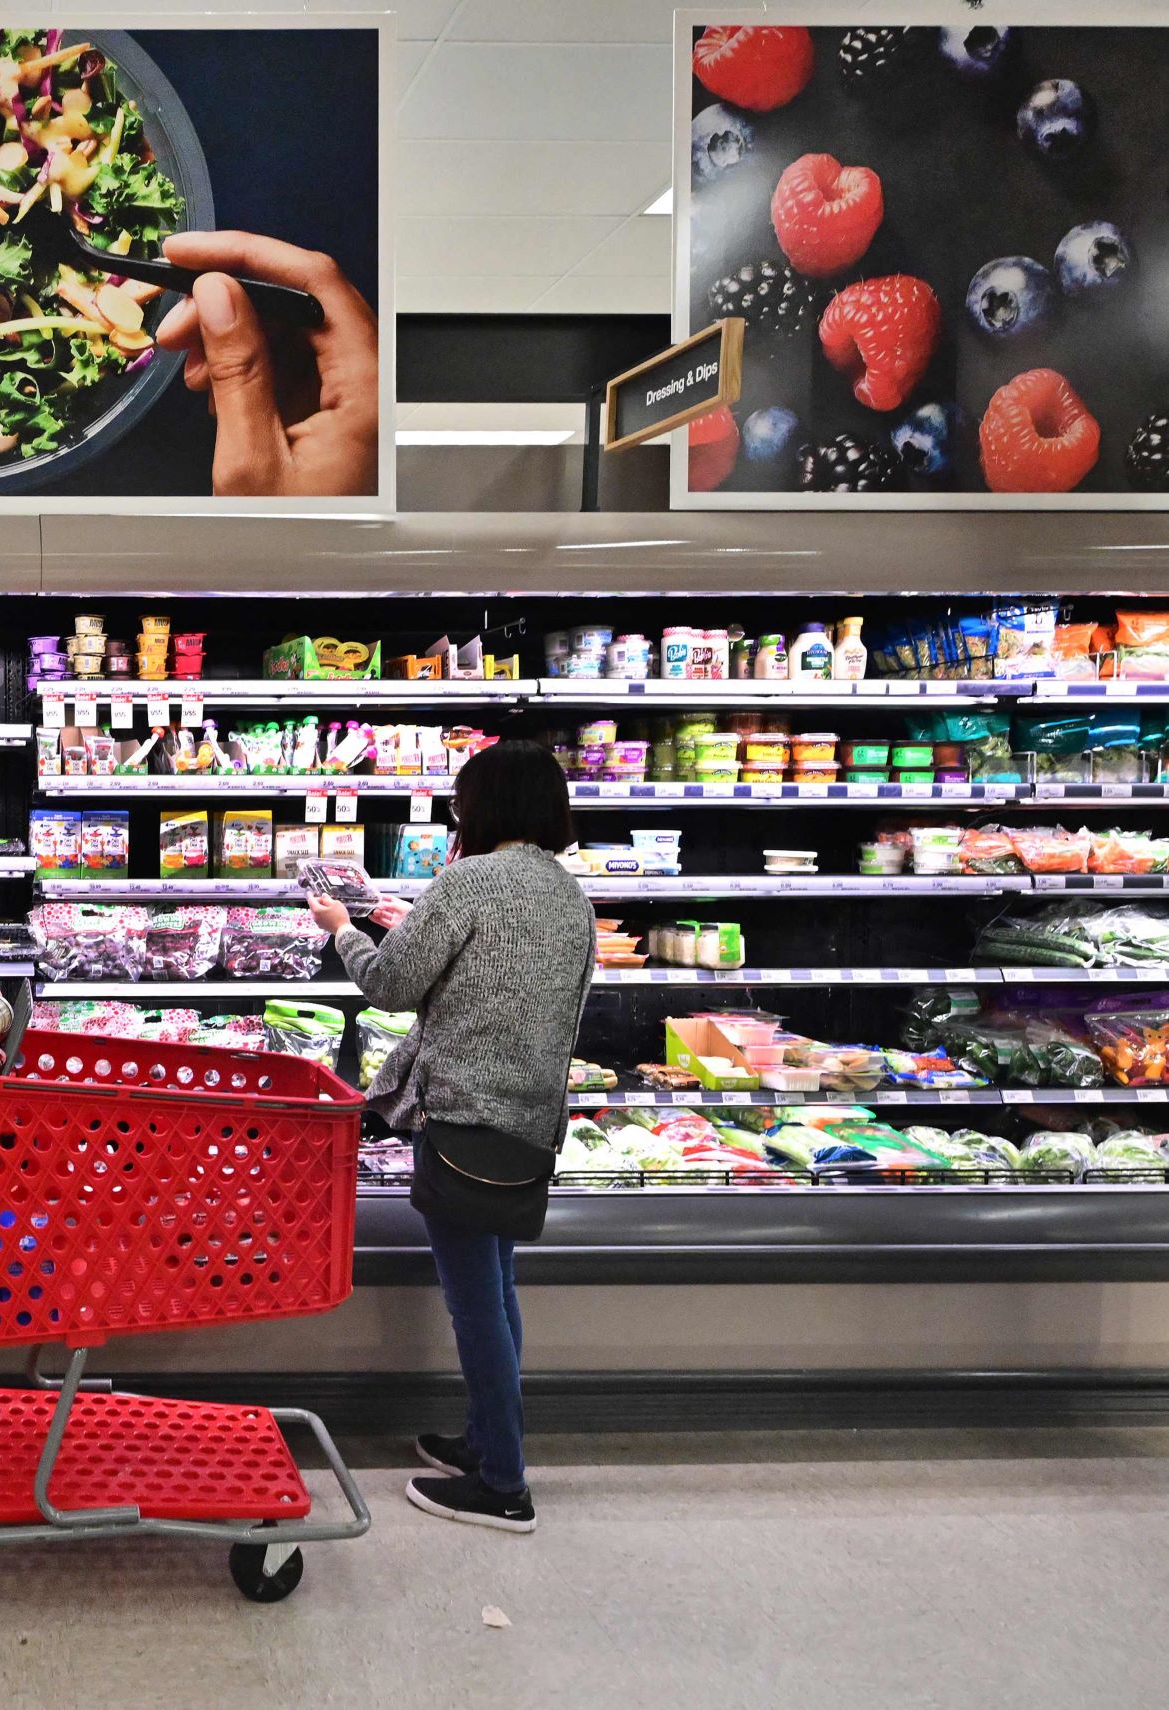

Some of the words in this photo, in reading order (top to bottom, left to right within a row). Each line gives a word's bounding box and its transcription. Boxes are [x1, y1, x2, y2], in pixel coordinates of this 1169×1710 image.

[646, 376, 684, 406] Dressing
[686, 371, 694, 387] &
[695, 361, 718, 383] Dips
